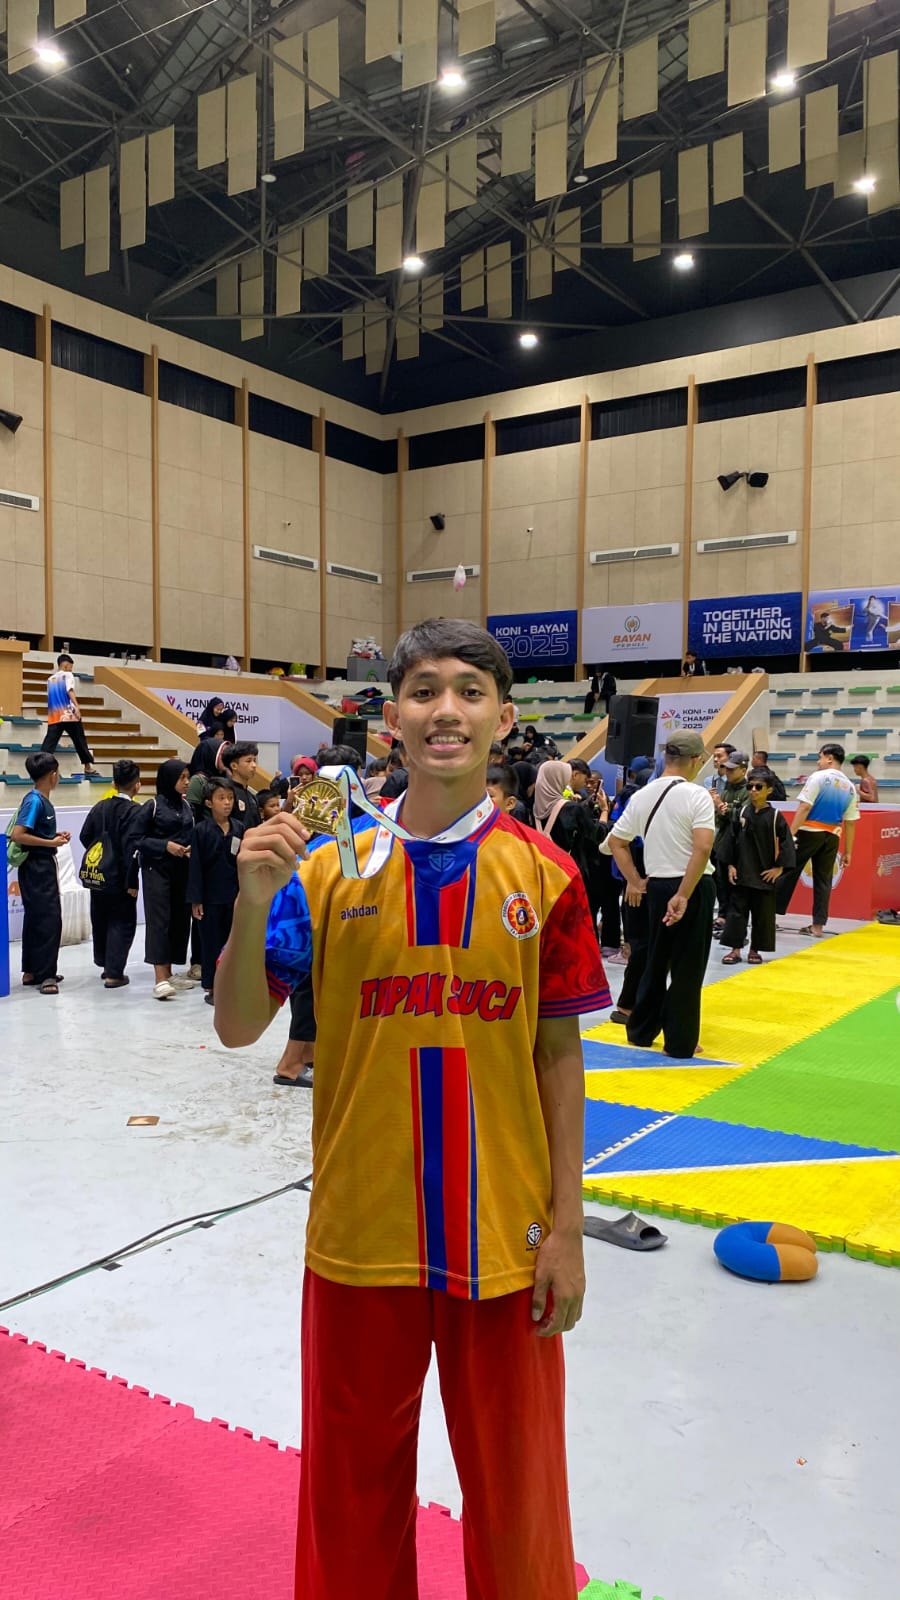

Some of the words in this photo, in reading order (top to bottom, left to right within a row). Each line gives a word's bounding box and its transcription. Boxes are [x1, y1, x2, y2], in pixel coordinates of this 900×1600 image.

[703, 606, 782, 622] TOGETHER
[495, 626, 521, 637] KONI
[530, 623, 569, 634] BAYAN
[703, 622, 718, 633] IN
[721, 617, 791, 632] BUILDING
[612, 633, 652, 644] BAYAN
[702, 632, 732, 644] THE
[735, 629, 792, 642] NATION
[495, 633, 569, 658] 2025
[223, 701, 249, 711] AYAN
[340, 904, 378, 920] akhdan
[446, 975, 522, 1022] SUCI
